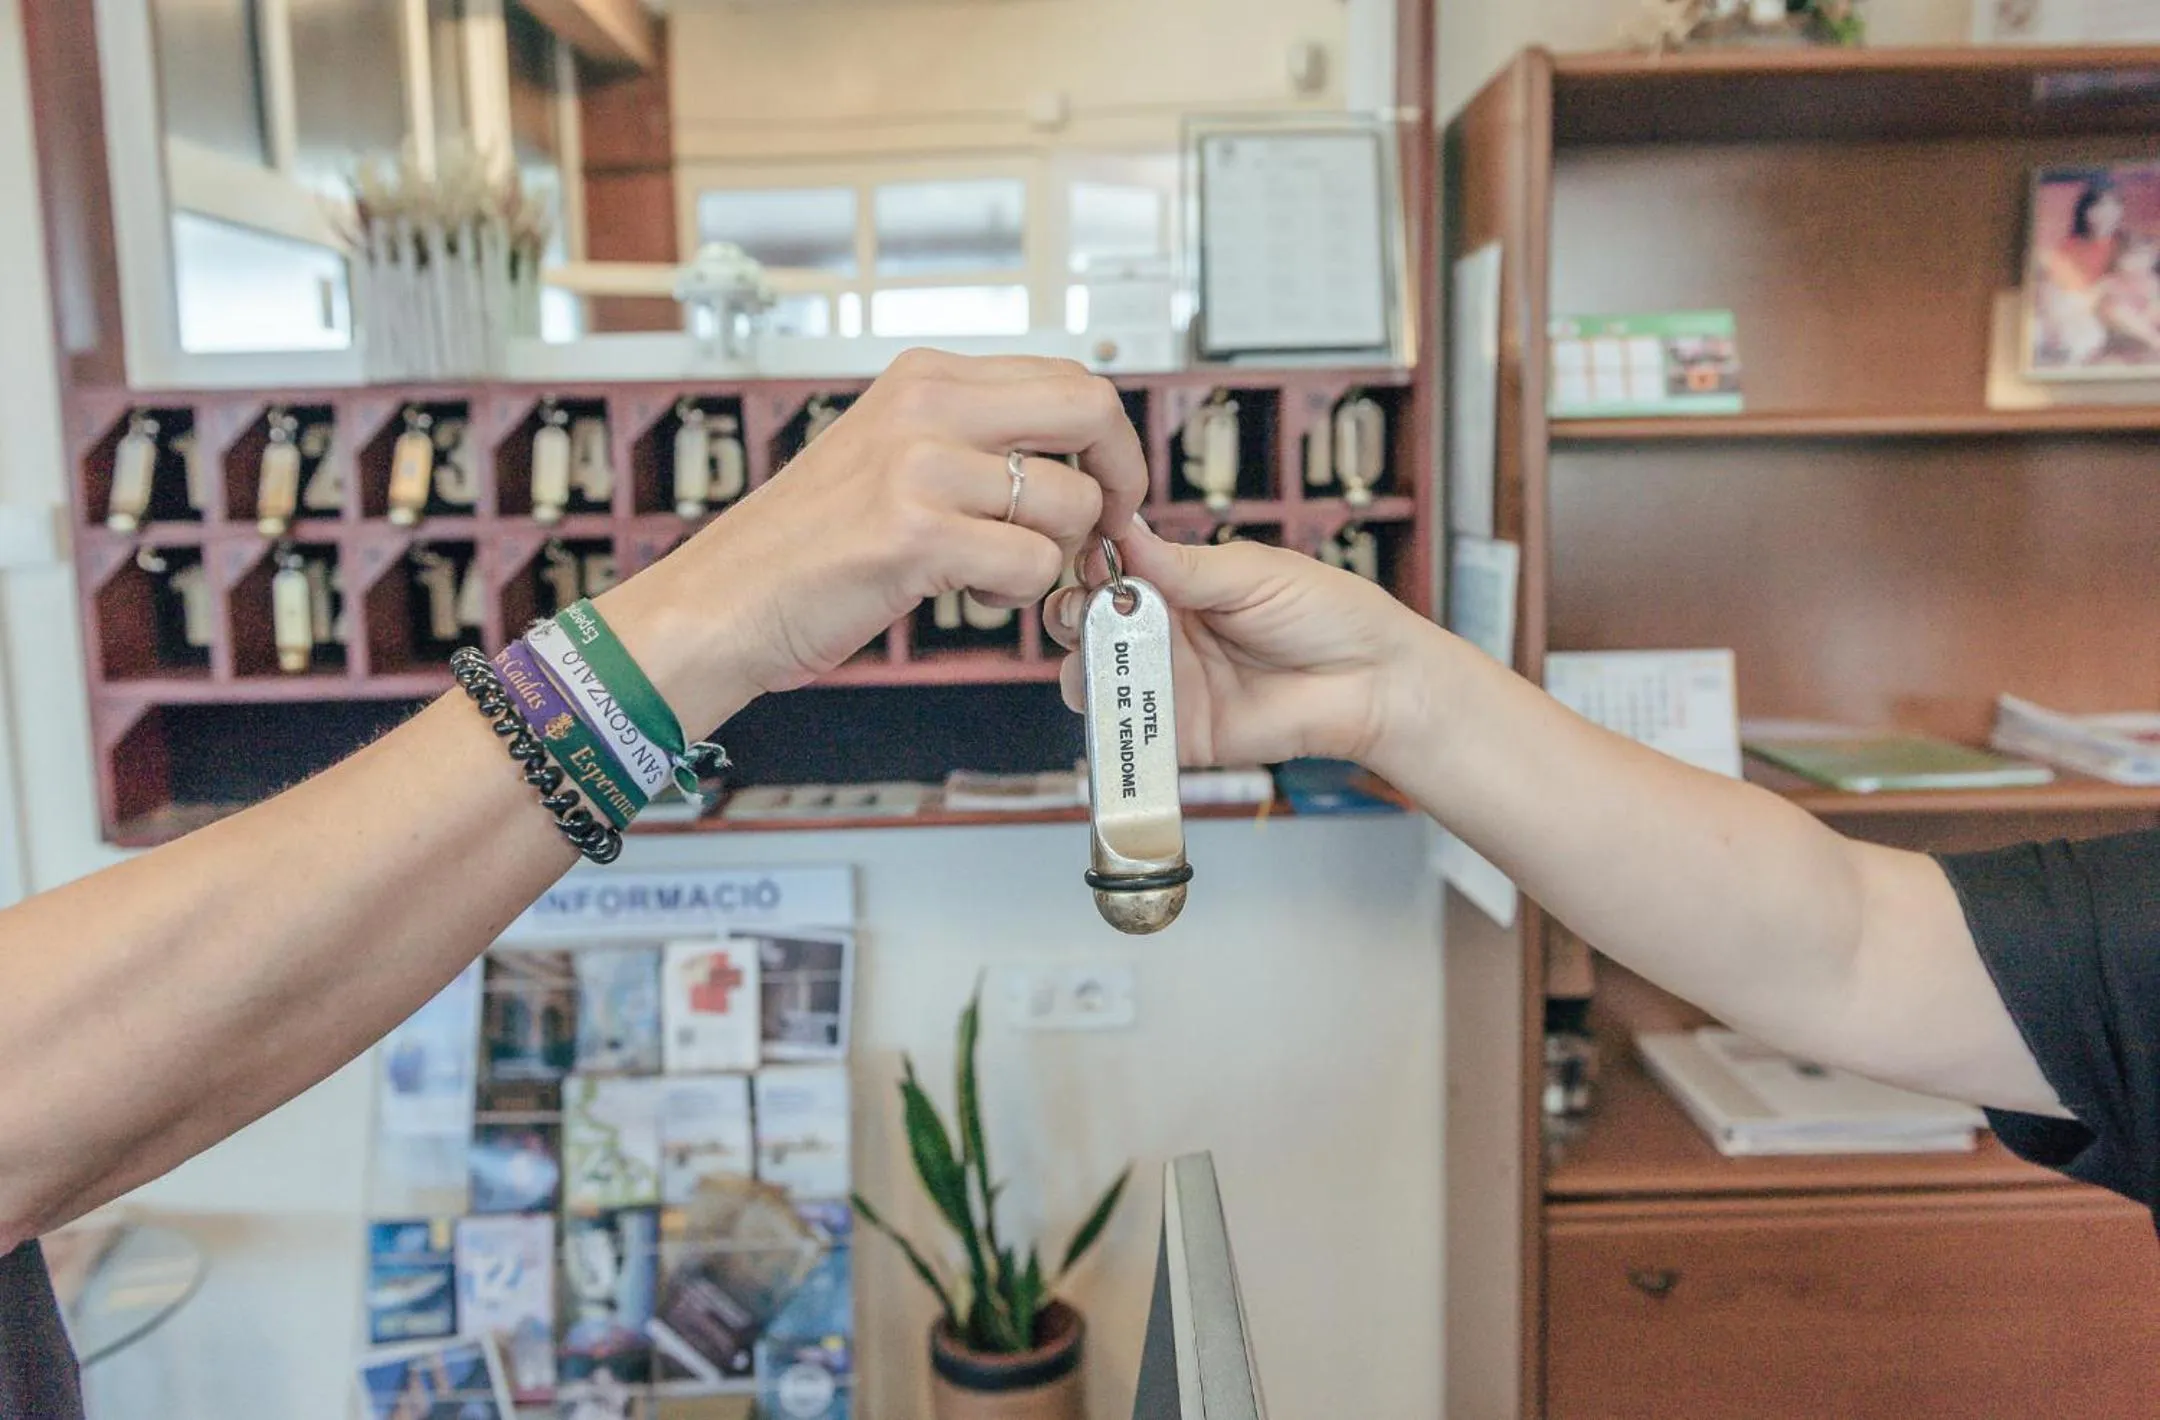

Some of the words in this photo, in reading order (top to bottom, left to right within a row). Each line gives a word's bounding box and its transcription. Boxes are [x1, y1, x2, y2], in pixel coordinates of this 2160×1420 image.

[302, 424, 347, 510] 2
[432, 418, 481, 503] 3
[569, 416, 613, 502] 4
[1114, 641, 1130, 677] DUC
[562, 649, 640, 746] GONZALO
[1116, 686, 1131, 709] DE
[1142, 690, 1158, 746] HOTEL
[631, 745, 664, 786] SAN
[1117, 717, 1136, 799] VENDOME
[540, 876, 780, 914] NFORMACIÓ
